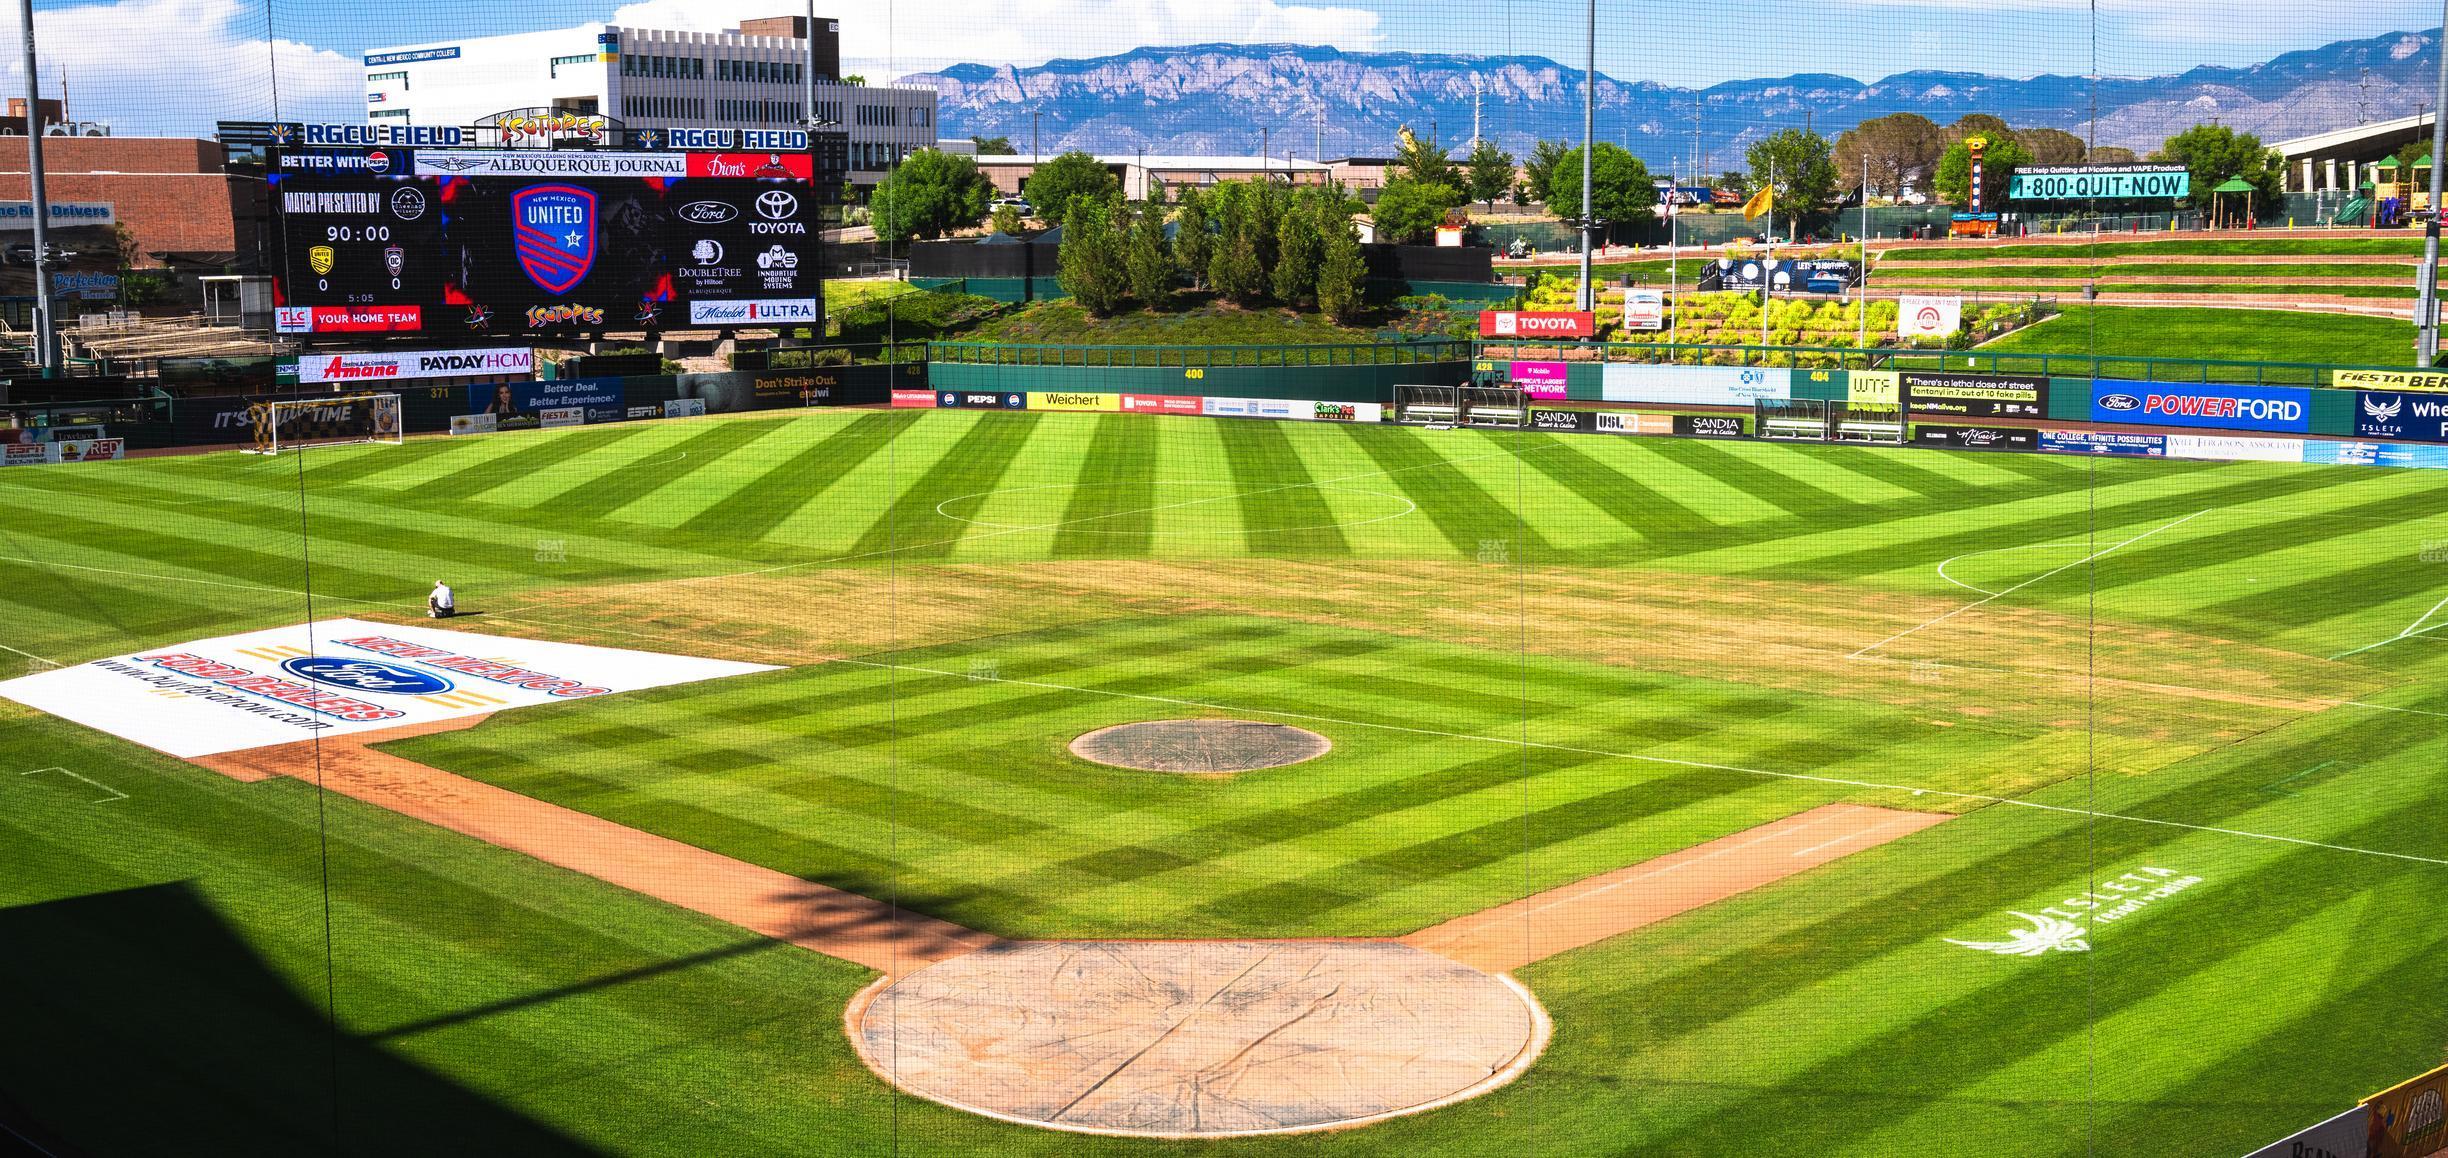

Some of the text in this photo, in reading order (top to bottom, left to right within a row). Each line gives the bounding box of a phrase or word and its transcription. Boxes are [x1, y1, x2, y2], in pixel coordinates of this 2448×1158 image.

[368, 56, 386, 64] CENTRAL
[396, 53, 411, 61] MEXICO
[412, 51, 436, 59] COMMUNITY
[436, 49, 456, 57] COLLEGE
[497, 111, 604, 142] ISOTOPES
[304, 124, 462, 146] RGCU FIELD
[668, 128, 808, 150] RGCU FIELD
[281, 156, 370, 168] BETTER WITH
[490, 158, 685, 174] ALBUQUERQUE JOURNAL
[706, 154, 746, 177] Dion's
[2033, 167, 2047, 175] Help
[2050, 166, 2078, 174] Quitting
[2152, 164, 2185, 172] Products
[284, 192, 380, 214] MATCH PRESENTED BY
[52, 205, 110, 218] Drivers
[528, 206, 583, 224] UNITED
[690, 204, 727, 220] Ford
[748, 222, 806, 234] TOYOTA
[54, 271, 118, 288] Perfection
[319, 279, 328, 291] 0
[392, 278, 400, 290] 0
[696, 278, 703, 286] by
[348, 294, 374, 302] 5:05
[280, 311, 305, 322] TLC
[318, 313, 417, 324] YOUR HOME TEAM
[526, 302, 604, 328] ISOTOPES
[695, 305, 812, 320] Michelob ULTRA
[1519, 318, 1577, 329] TOYOTA
[420, 352, 529, 370] PAYDAY HCM
[1476, 362, 1493, 372] 428
[324, 356, 399, 379] Amana
[907, 366, 920, 375] 428
[1185, 368, 1204, 380] 400
[1810, 372, 1829, 382] 404
[2340, 372, 2404, 382] FIESTA
[544, 382, 598, 393] Better Deal.
[755, 376, 836, 388] Don't Strike Out.
[1854, 378, 1890, 393] WTF
[1913, 378, 1942, 387] There's
[1950, 379, 1974, 388] lethal
[1976, 380, 1996, 388] dose
[1998, 381, 2008, 389] of
[2009, 382, 2034, 390] street
[430, 388, 449, 399] 371
[1524, 384, 1566, 393] NETWORK
[1912, 387, 1946, 396] fentanyl
[1996, 390, 2014, 398] fake
[2015, 391, 2034, 400] pills.
[529, 398, 559, 406] Better
[968, 395, 996, 404] PEPSI
[1045, 393, 1100, 406] Weichert
[2106, 395, 2132, 410] Ford
[1314, 402, 1355, 414] Clark's Pet
[2144, 395, 2301, 422] POWERFORD
[214, 406, 352, 428] IT'S TIME
[541, 410, 569, 420] FIESTA
[1535, 412, 1578, 423] SANDIA
[1598, 415, 1624, 429] USL
[1692, 418, 1739, 429] SANDIA
[2361, 424, 2401, 432] ISLETA
[2042, 432, 2056, 440] ONE
[2057, 433, 2087, 441] COLLEGE,
[2088, 434, 2114, 442] INFINITE
[2117, 435, 2163, 444] POSSIBILITIES
[90, 441, 119, 455] RED
[331, 636, 612, 698] NEW MEXICO
[311, 662, 424, 690] Ford
[134, 652, 406, 722] FORD DEALERS
[91, 660, 334, 730] www.buyfordnow.com
[2041, 866, 2178, 919] ISLETA
